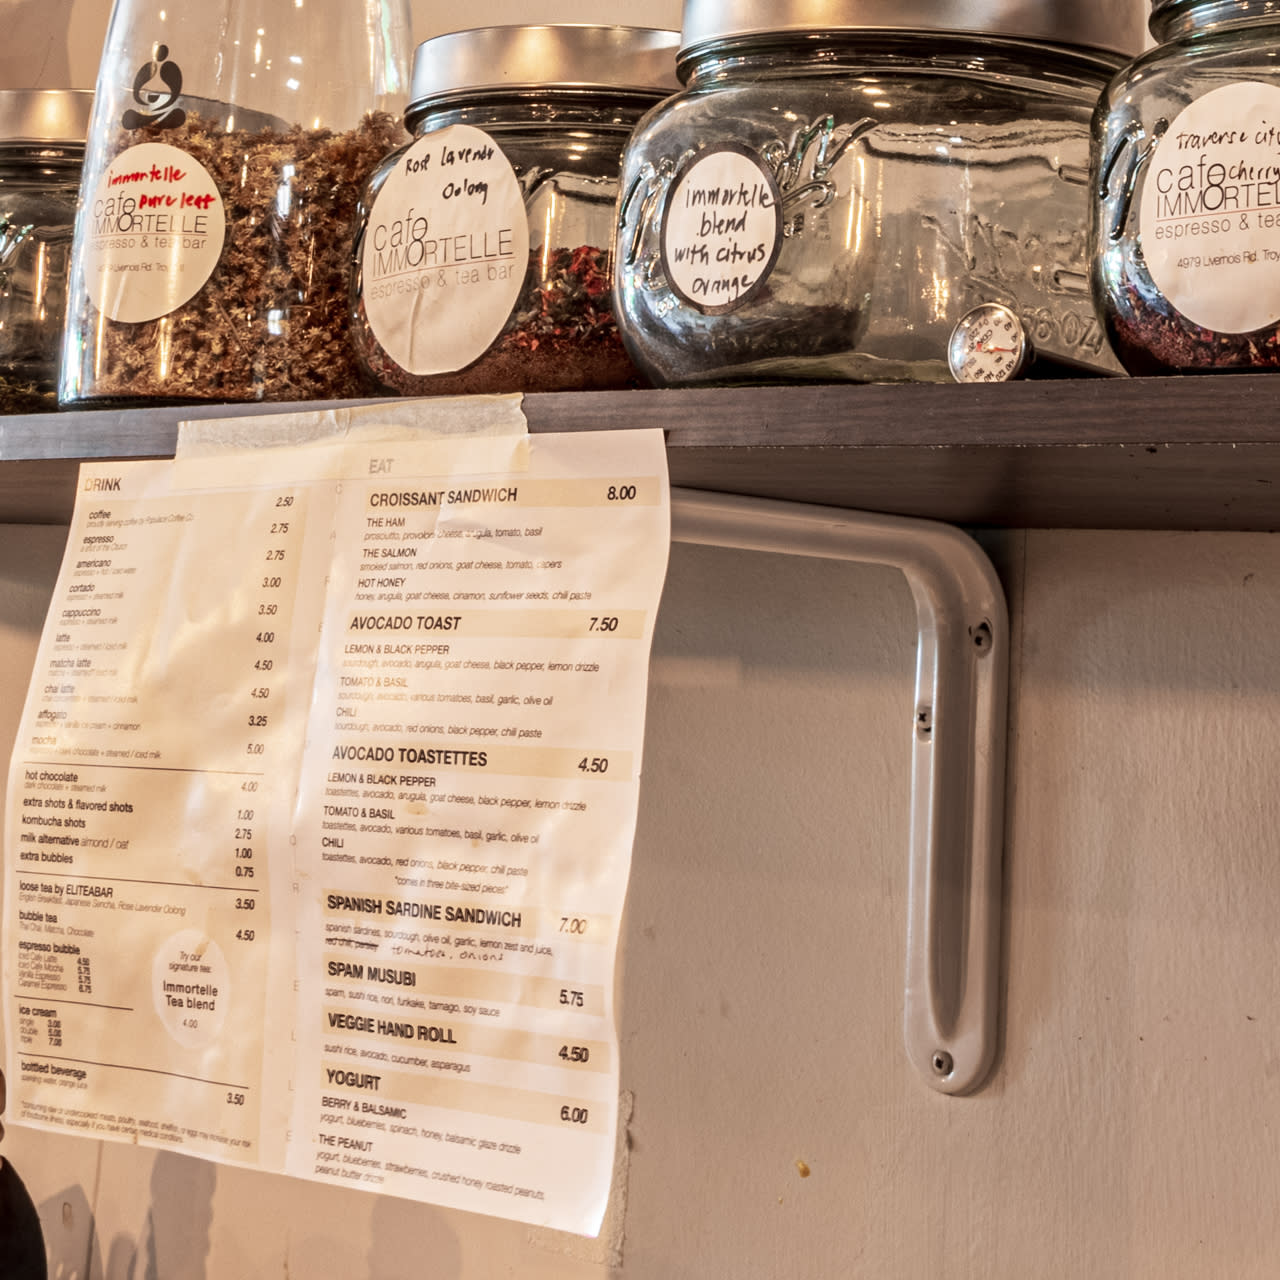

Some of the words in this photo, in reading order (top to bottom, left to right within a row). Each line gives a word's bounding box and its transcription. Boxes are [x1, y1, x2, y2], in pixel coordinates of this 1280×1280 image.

[108, 164, 186, 187] immortelle
[406, 155, 430, 175] Rose
[1156, 154, 1225, 194] cafe
[1229, 160, 1280, 185] cherry
[95, 191, 136, 218] cafe
[139, 193, 178, 209] pure
[180, 192, 216, 209] leaf
[686, 180, 776, 208] immortelle
[95, 214, 208, 233] MMORTELLE
[374, 208, 428, 251] cafe
[700, 211, 747, 237] blend
[1155, 220, 1231, 240] espresso
[1239, 214, 1249, 230] &
[183, 238, 206, 248] bar
[373, 229, 513, 276] IMMORTELLE
[674, 244, 709, 265] with
[716, 238, 765, 264] citrus
[1177, 258, 1201, 269] 4979
[437, 270, 448, 288] &
[456, 269, 480, 284] tea
[488, 264, 515, 280] bar
[692, 275, 754, 298] orange
[84, 478, 121, 492] DRINK
[370, 492, 445, 507] CROISSANT
[447, 487, 518, 504] SANDWICH
[608, 485, 637, 501] 8.00
[89, 510, 112, 520] coffee
[276, 496, 294, 508] 2.50
[367, 518, 384, 527] THE
[386, 517, 406, 526] HAM
[83, 535, 114, 544] espresso
[270, 523, 289, 534] 2.75
[363, 549, 379, 557] THE
[380, 548, 417, 557] SALMON
[456, 561, 472, 571] goat
[358, 579, 375, 587] HOT
[377, 578, 406, 587] HONEY
[350, 616, 412, 629] AVOCADO
[417, 616, 461, 630] TOAST
[589, 617, 619, 631] 7.50
[344, 645, 374, 654] LEMON
[375, 645, 382, 654] &
[384, 645, 412, 654] BLACK
[414, 645, 449, 655] PEPPER
[493, 661, 514, 670] black
[548, 662, 573, 671] lemon
[523, 695, 542, 705] olive
[406, 725, 417, 733] red
[448, 725, 468, 735] black
[519, 728, 542, 739] paste
[332, 745, 394, 762] AVOCADO
[398, 748, 487, 767] TOASTETTES
[578, 757, 609, 773] 4.50
[25, 769, 38, 780] hot
[40, 771, 78, 782] chocolate
[328, 773, 357, 783] LEMON
[359, 774, 365, 783] &
[367, 774, 397, 785] BLACK
[400, 776, 436, 787] PEPPER
[23, 798, 42, 808] extra
[44, 798, 66, 810] shots
[68, 800, 74, 810] &
[76, 800, 107, 812] flavored
[109, 802, 134, 814] shots
[237, 810, 254, 820] 1.00
[323, 806, 359, 817] TOMATO
[361, 808, 367, 817] &
[369, 808, 395, 819] BASIL
[22, 814, 62, 827] kombucha
[64, 816, 86, 828] shots
[235, 829, 252, 840] 2.75
[20, 833, 36, 844] milk
[38, 834, 80, 846] alternative
[80, 836, 109, 848] almond
[235, 848, 252, 858] 1.00
[322, 837, 344, 848] CHILI
[20, 850, 40, 862] extra
[41, 852, 74, 864] bubbles
[236, 866, 254, 878] 0.75
[20, 880, 39, 892] loose
[40, 884, 53, 894] tea
[54, 885, 64, 896] by
[236, 899, 254, 910] 3.50
[327, 895, 382, 914] SPANISH
[386, 901, 441, 920] SARDINE
[445, 907, 521, 928] SANDWICH
[559, 917, 587, 934] 7.00
[236, 930, 255, 942] 4.50
[163, 980, 218, 996] Immortelle
[328, 962, 364, 979] SPAM
[367, 967, 416, 986] MUSUBI
[560, 989, 584, 1006] 5.75
[166, 996, 184, 1008] Tea
[186, 998, 216, 1010] blend
[328, 1013, 375, 1033] VEGGIE
[377, 1021, 415, 1039] HAND
[417, 1026, 457, 1043] ROLL
[558, 1046, 589, 1062] 4.50
[326, 1069, 381, 1091] YOGURT
[560, 1105, 588, 1123] 6.00
[322, 1097, 352, 1110] BERRY
[353, 1100, 360, 1111] &
[361, 1102, 407, 1119] BALSAMIC
[319, 1134, 336, 1145] THE
[337, 1136, 373, 1152] PEANUT
